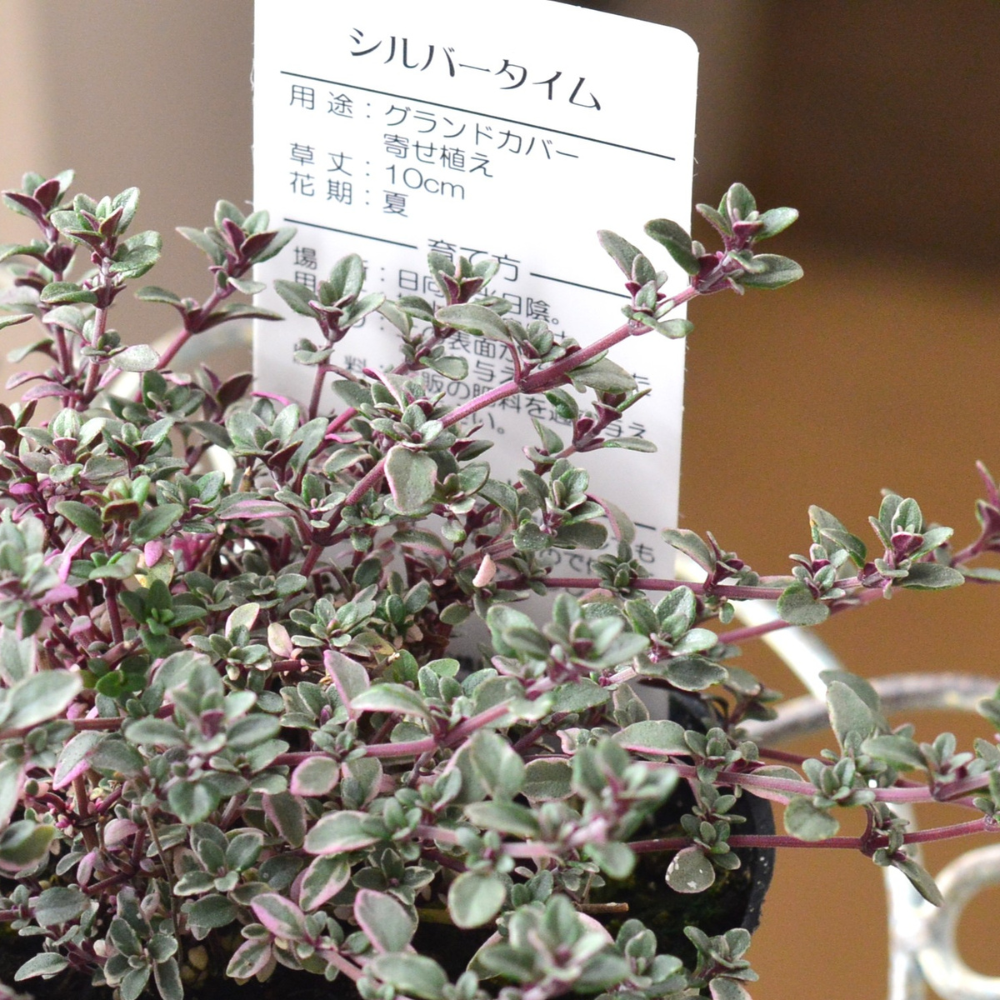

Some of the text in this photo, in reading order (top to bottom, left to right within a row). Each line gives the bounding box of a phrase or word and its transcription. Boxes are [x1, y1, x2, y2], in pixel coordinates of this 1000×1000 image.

[348, 27, 602, 112] シルバータイム
[383, 133, 494, 179] 寄せ植え
